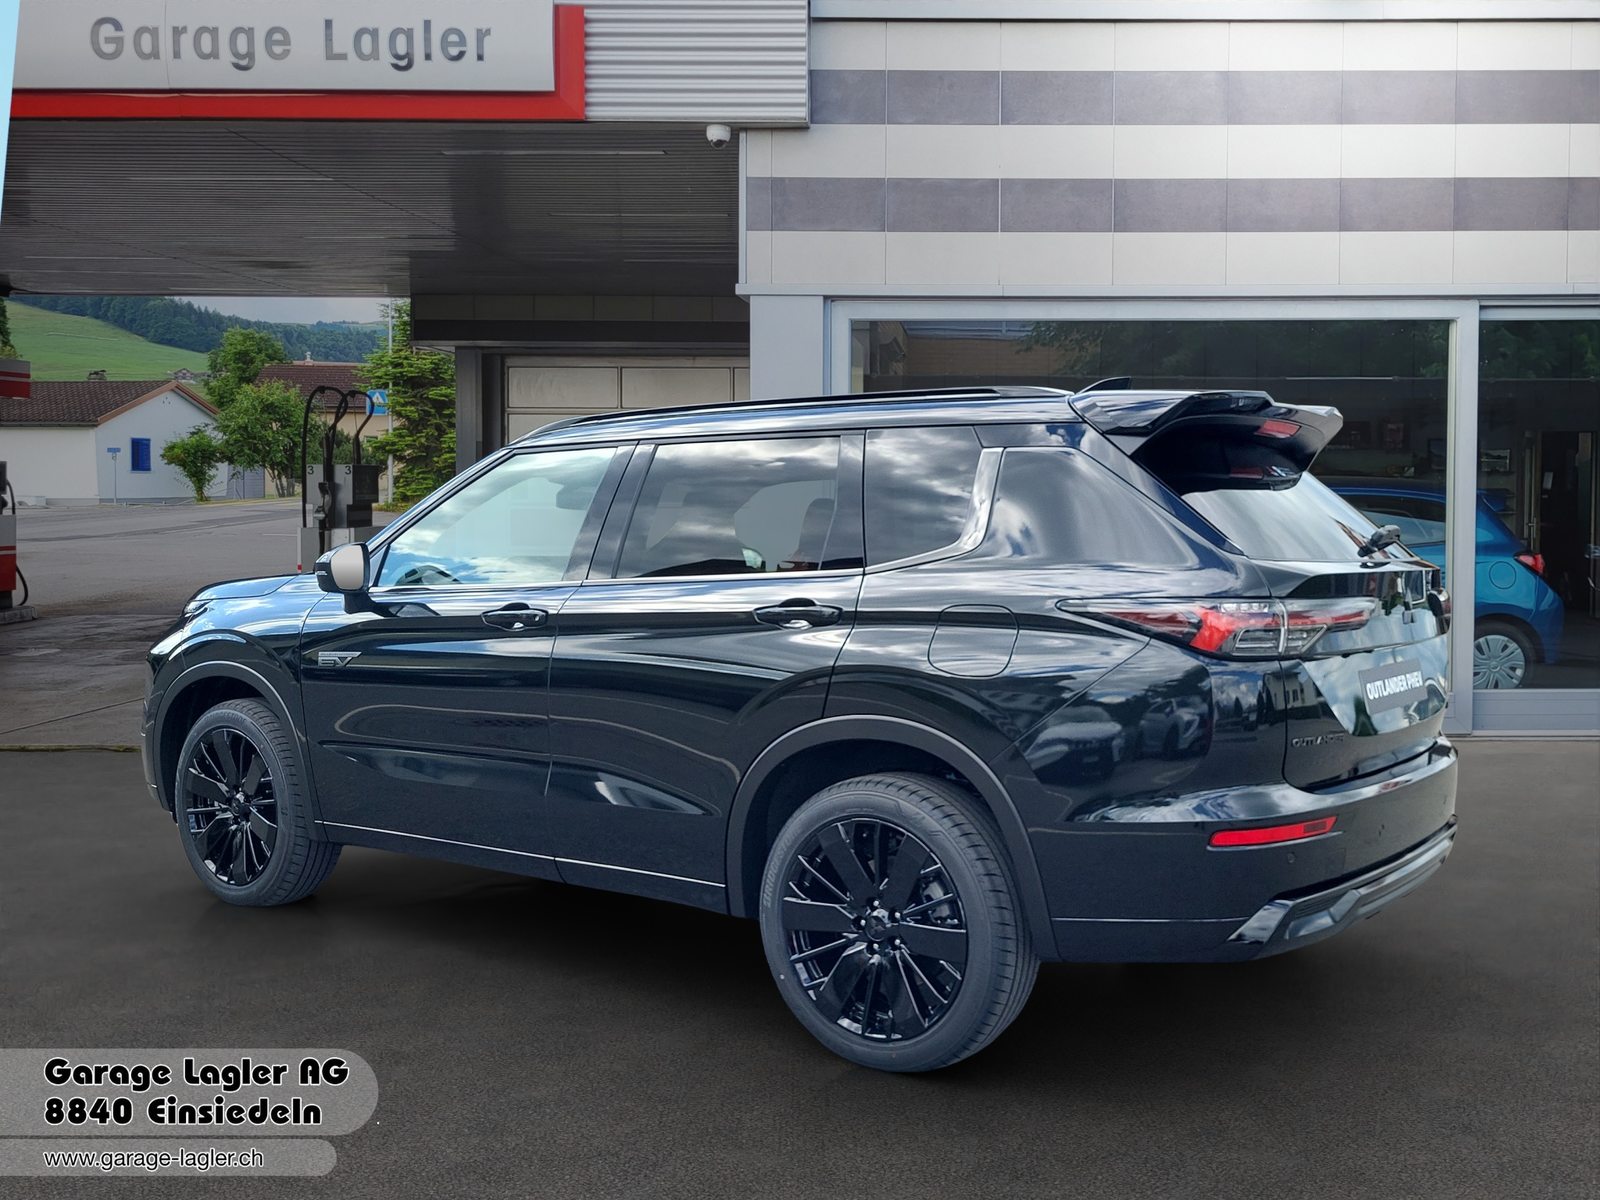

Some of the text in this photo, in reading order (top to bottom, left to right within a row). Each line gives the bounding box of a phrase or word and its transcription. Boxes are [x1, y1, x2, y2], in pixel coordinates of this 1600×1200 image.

[90, 16, 492, 72] Garage Lagler
[307, 465, 314, 475] 3
[344, 465, 352, 475] 3
[1366, 674, 1408, 700] OUTLANDER
